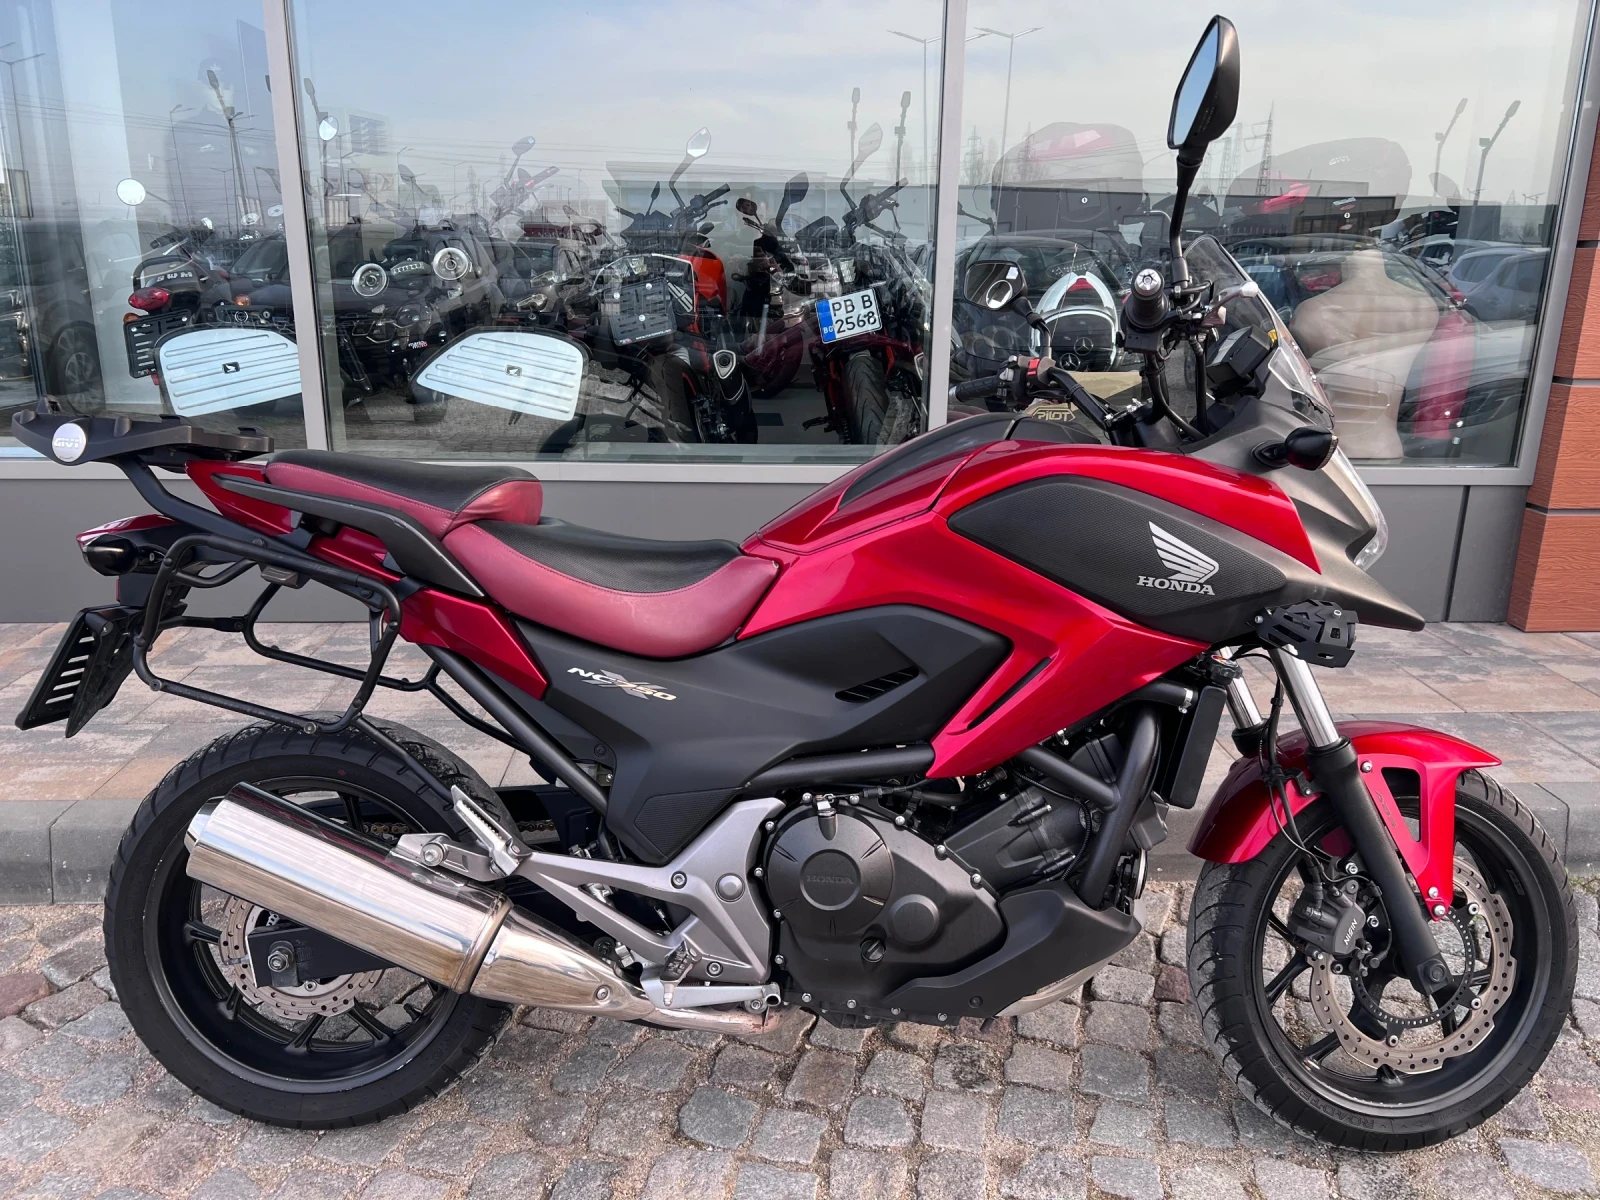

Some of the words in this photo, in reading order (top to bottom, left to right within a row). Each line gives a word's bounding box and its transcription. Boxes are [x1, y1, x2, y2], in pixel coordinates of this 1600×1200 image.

[831, 299, 855, 317] PB
[861, 294, 873, 309] B
[835, 311, 877, 334] 2568
[1136, 575, 1216, 596] HONDA
[806, 875, 855, 885] HONDA
